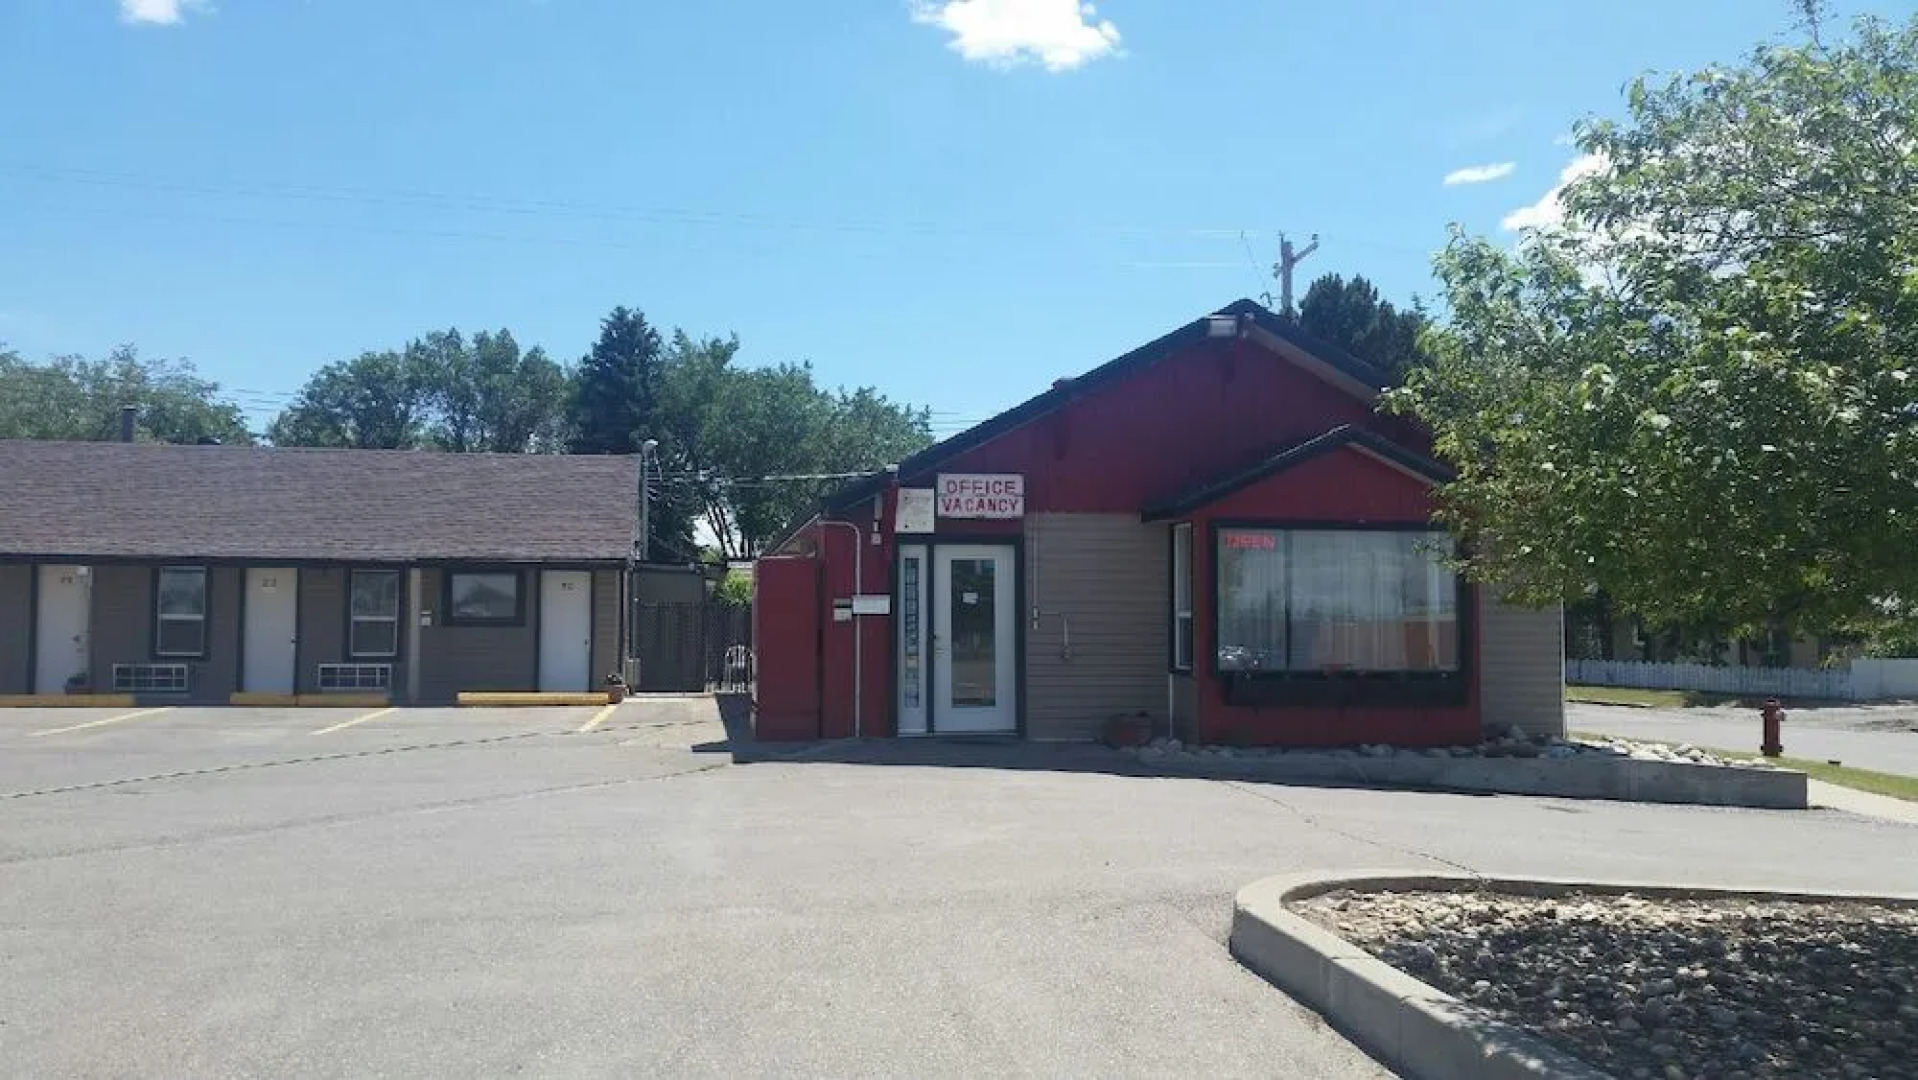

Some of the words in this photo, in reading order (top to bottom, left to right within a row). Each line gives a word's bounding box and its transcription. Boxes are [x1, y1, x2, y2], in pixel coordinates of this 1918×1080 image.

[946, 480, 1016, 494] OFFICE
[941, 498, 1018, 512] VACANCY
[1226, 534, 1276, 549] OPEN
